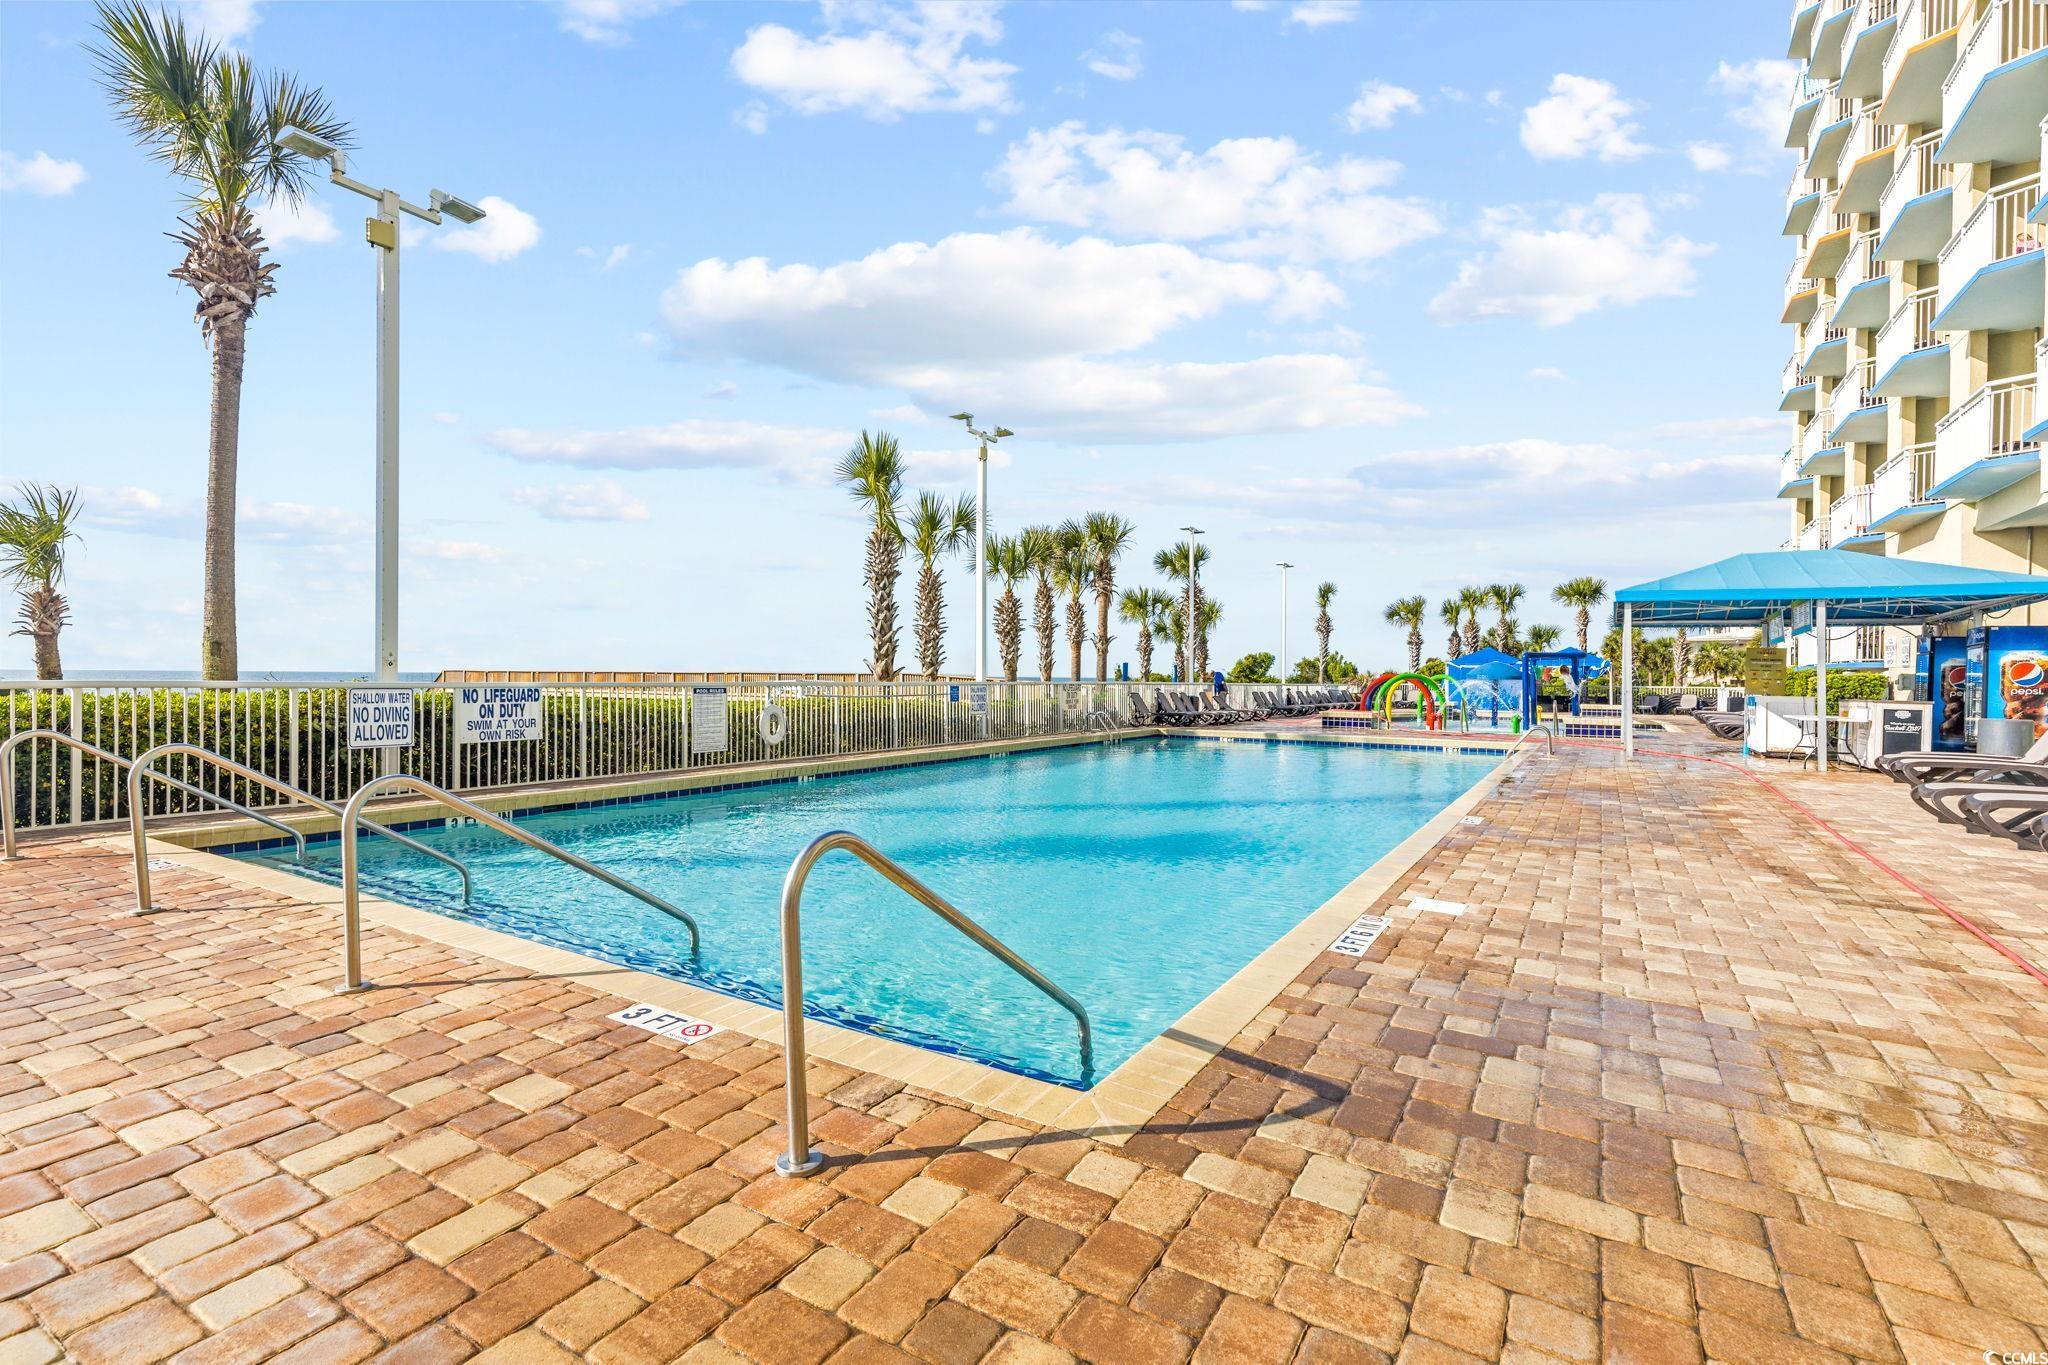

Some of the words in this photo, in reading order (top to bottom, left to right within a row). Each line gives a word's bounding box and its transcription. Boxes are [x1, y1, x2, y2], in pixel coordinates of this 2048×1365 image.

[352, 692, 385, 704] SHALLOW
[388, 692, 410, 704] WATER
[462, 688, 479, 704] NO
[484, 687, 540, 703] LIFEGUARD
[2010, 687, 2042, 697] pepsi
[353, 706, 369, 723] NO
[373, 706, 410, 722] DIVING
[479, 703, 494, 719] ON
[499, 703, 526, 718] DUTY
[467, 720, 493, 731] SWIM
[496, 719, 508, 729] AT
[512, 718, 537, 729] YOUR
[354, 724, 409, 741] ALLOWED
[479, 730, 502, 741] OWN
[505, 729, 526, 740] RISK
[1340, 935, 1369, 947] FT
[1335, 945, 1360, 953] 3
[622, 1008, 652, 1019] 3
[642, 1014, 688, 1030] FT
